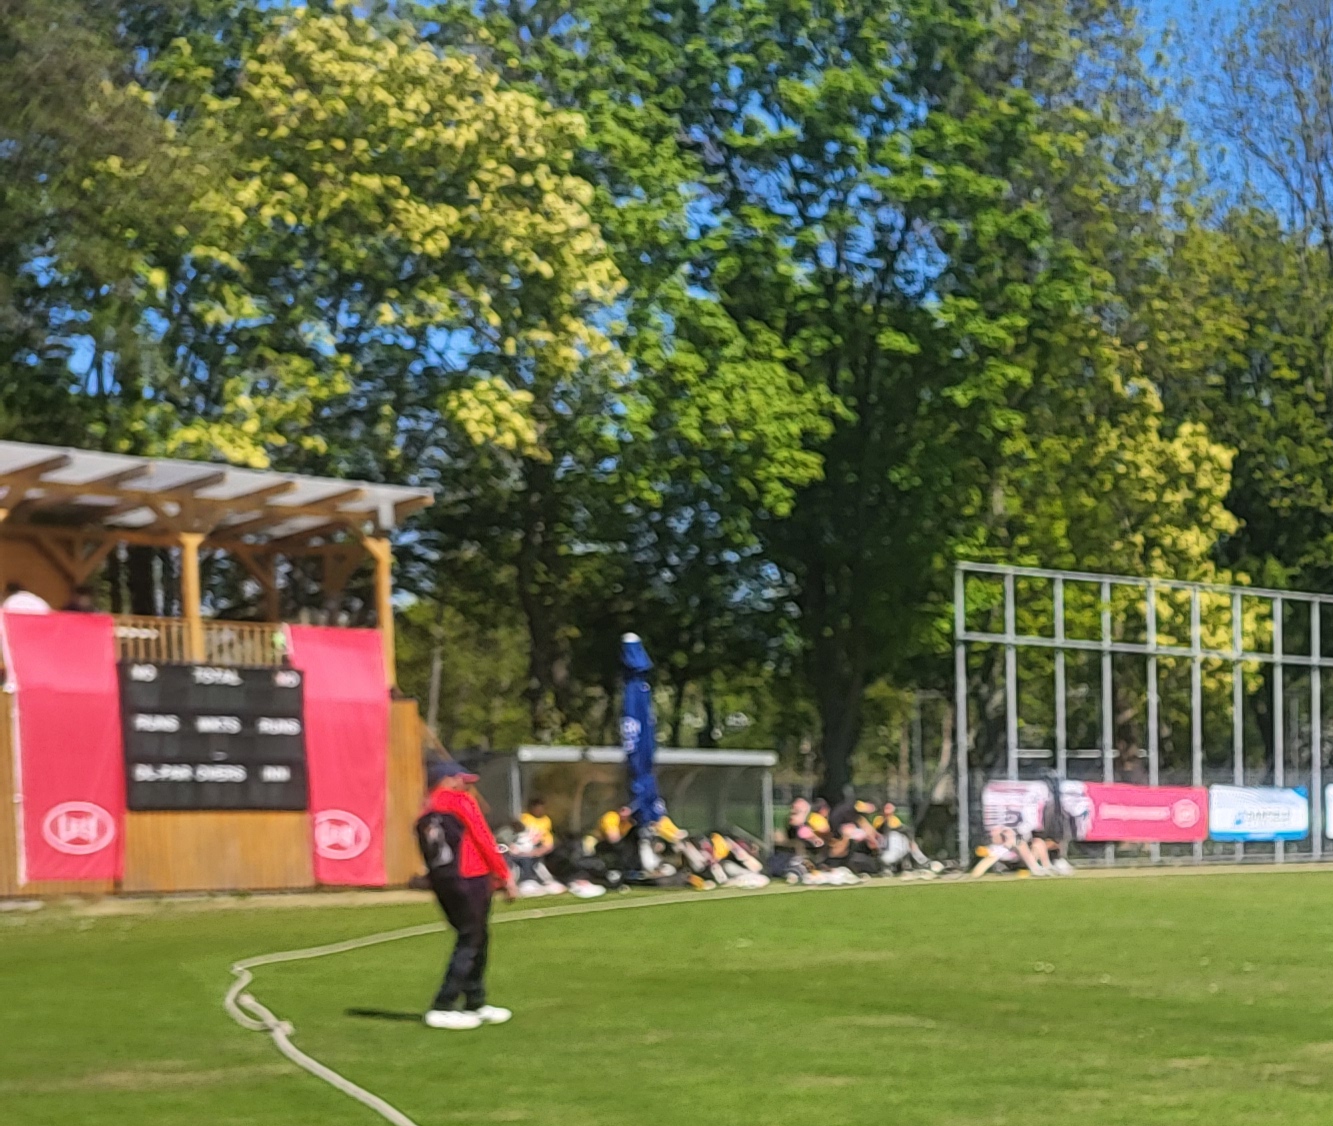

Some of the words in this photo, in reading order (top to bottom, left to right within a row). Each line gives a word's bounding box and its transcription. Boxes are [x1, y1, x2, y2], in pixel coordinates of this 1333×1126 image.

[193, 667, 243, 685] TOTAL
[134, 714, 180, 732] RUNS
[258, 717, 301, 735] RUNS
[196, 764, 247, 783] OVERS
